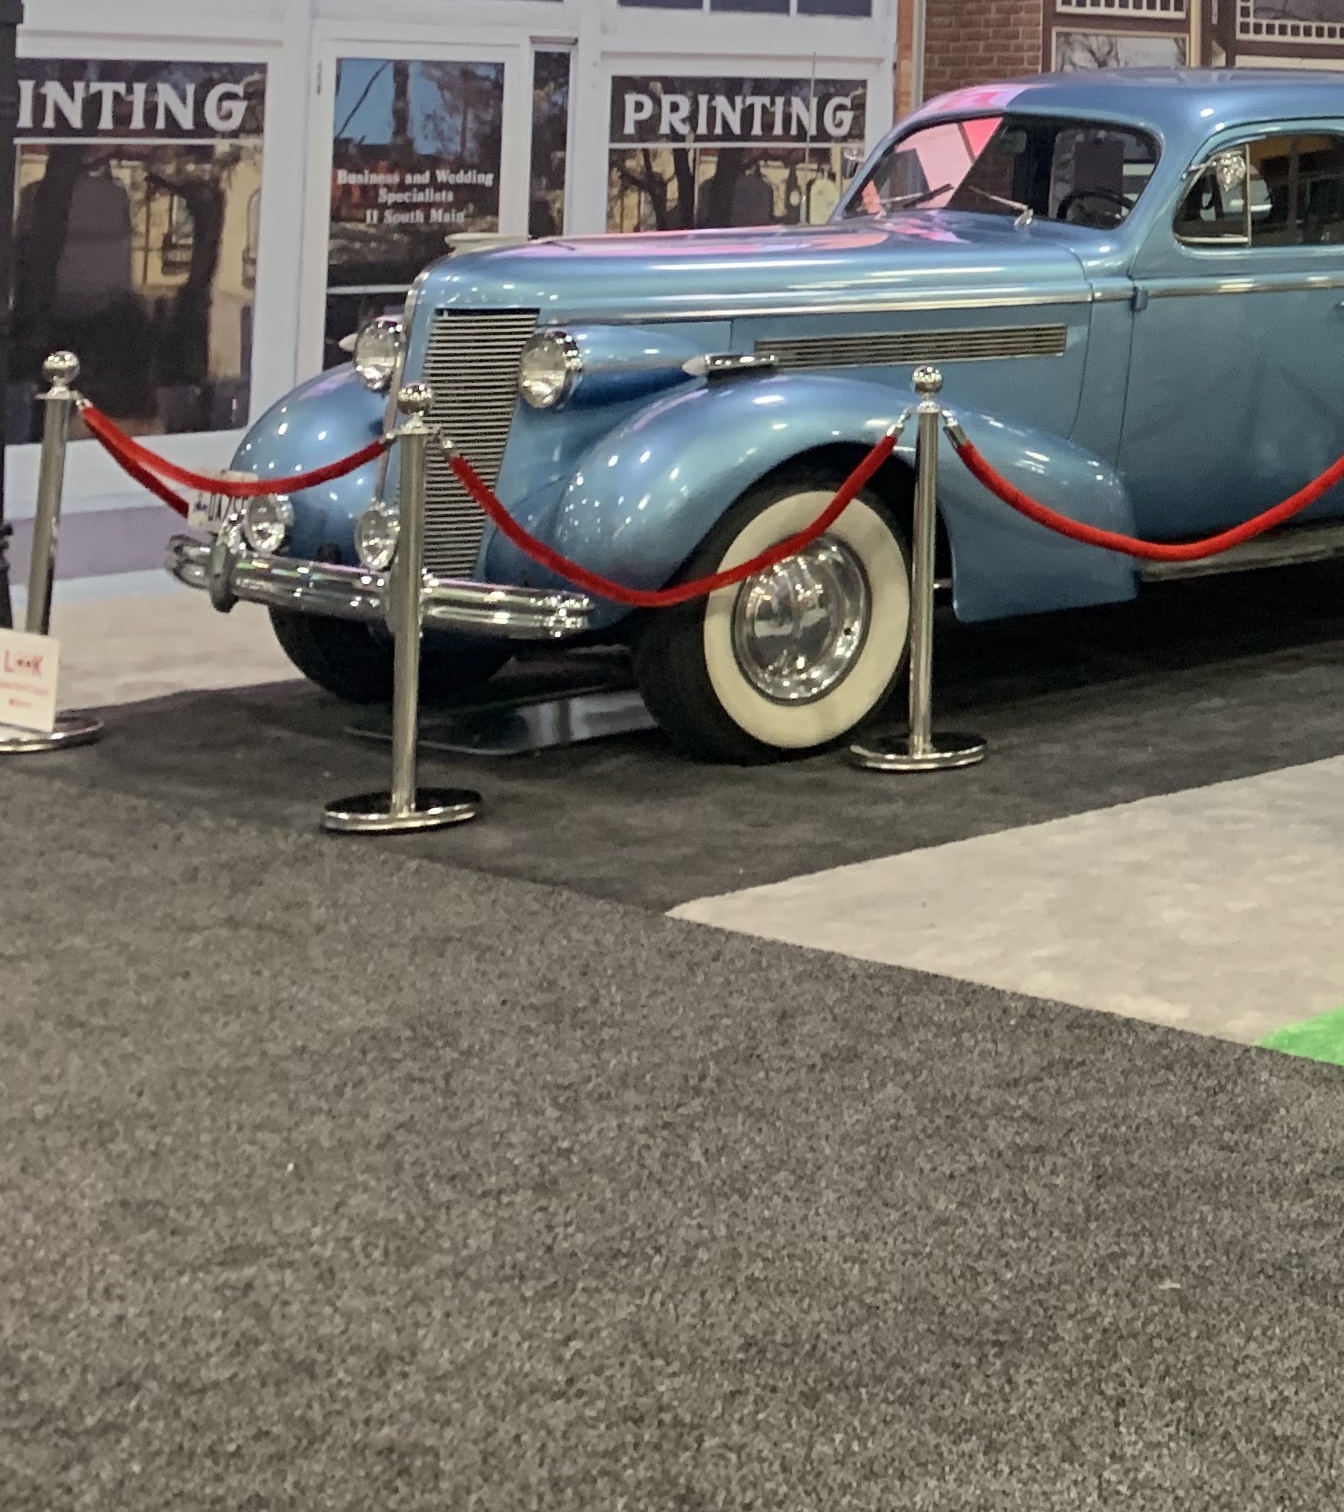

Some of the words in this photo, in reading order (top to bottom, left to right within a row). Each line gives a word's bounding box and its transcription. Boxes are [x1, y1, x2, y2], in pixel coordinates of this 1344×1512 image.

[16, 79, 249, 132] INTING
[622, 93, 856, 138] PRINTING
[337, 168, 400, 185] Business
[404, 169, 430, 186] and
[435, 169, 495, 187] Wedding
[377, 188, 454, 205] Specialists
[383, 209, 425, 224] South
[429, 208, 466, 224] Main
